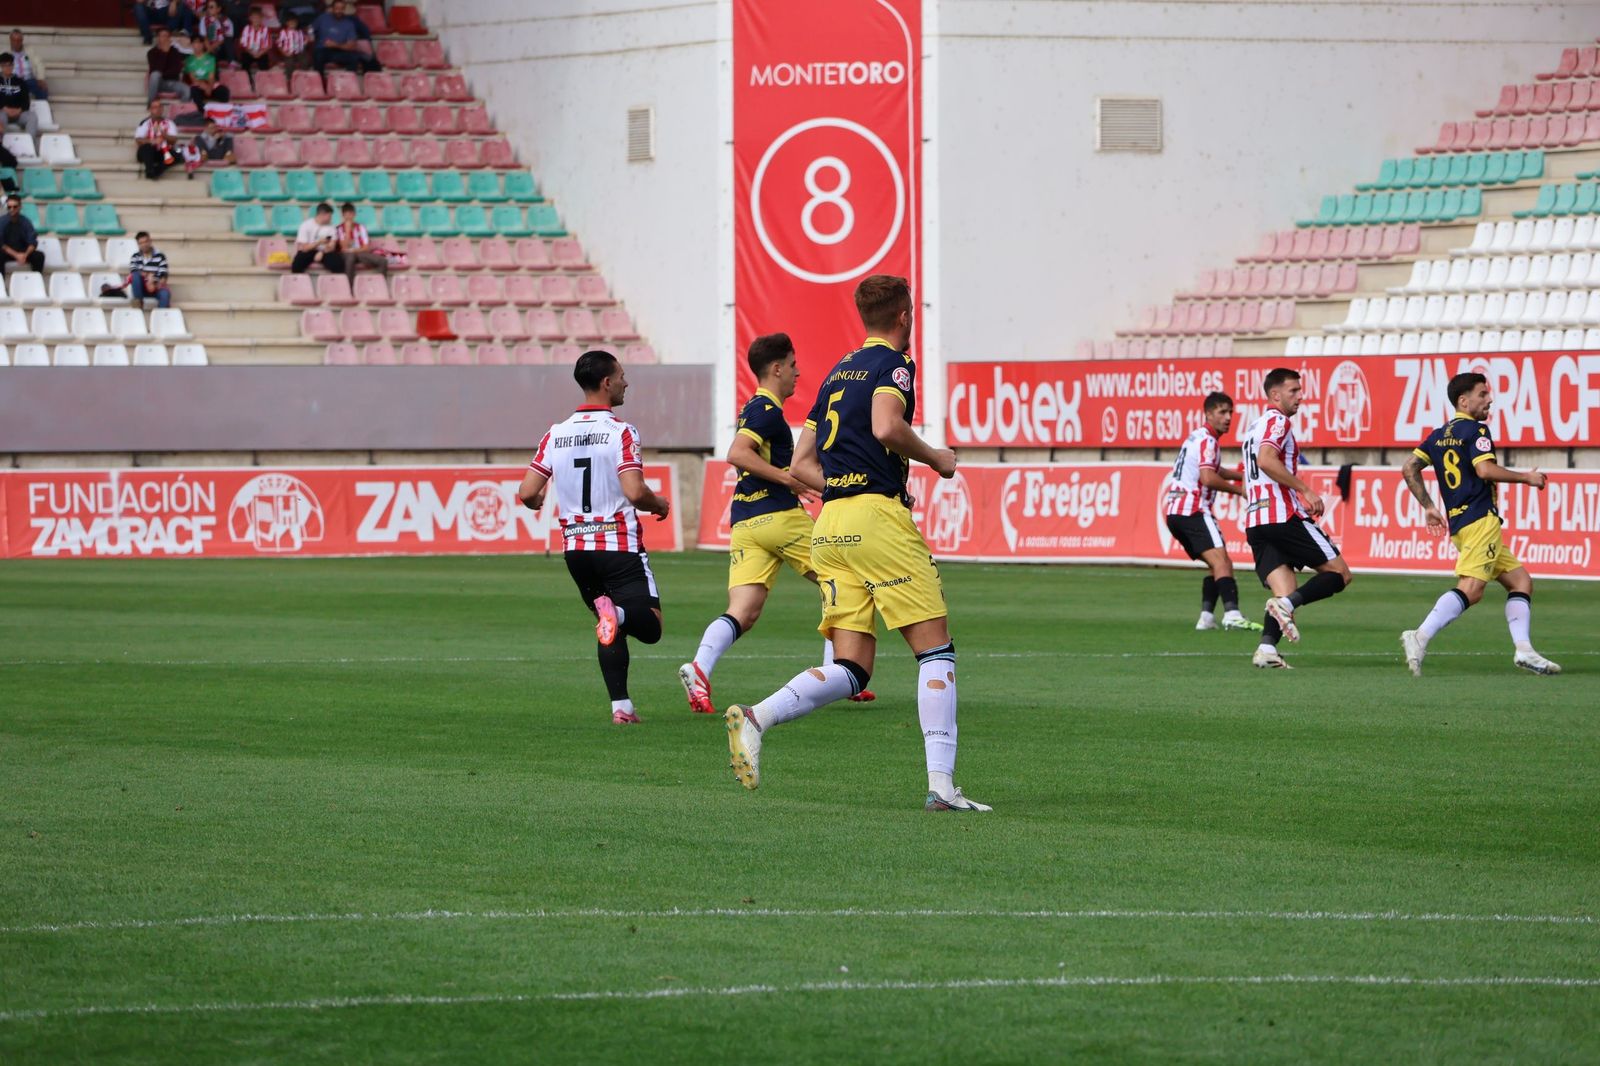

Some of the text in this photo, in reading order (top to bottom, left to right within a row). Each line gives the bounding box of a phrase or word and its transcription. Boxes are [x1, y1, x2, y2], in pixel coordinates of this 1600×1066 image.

[750, 61, 905, 86] MONTETORO
[801, 156, 854, 245] 8
[1085, 364, 1224, 398] www.cubiex.es
[822, 386, 846, 451] 5
[949, 366, 1082, 443] cubiex
[1126, 409, 1207, 440] 675 630 11
[554, 435, 573, 449] KIKE
[573, 457, 592, 513] 7
[1443, 448, 1462, 490] 8
[28, 473, 216, 514] FUNDACIÓN
[1023, 470, 1122, 528] Freigel
[1355, 478, 1389, 528] E.S.
[1515, 482, 1541, 531] LA
[1369, 531, 1434, 560] Morales
[1510, 534, 1591, 568] (Zamora)
[1486, 543, 1497, 559] 8
